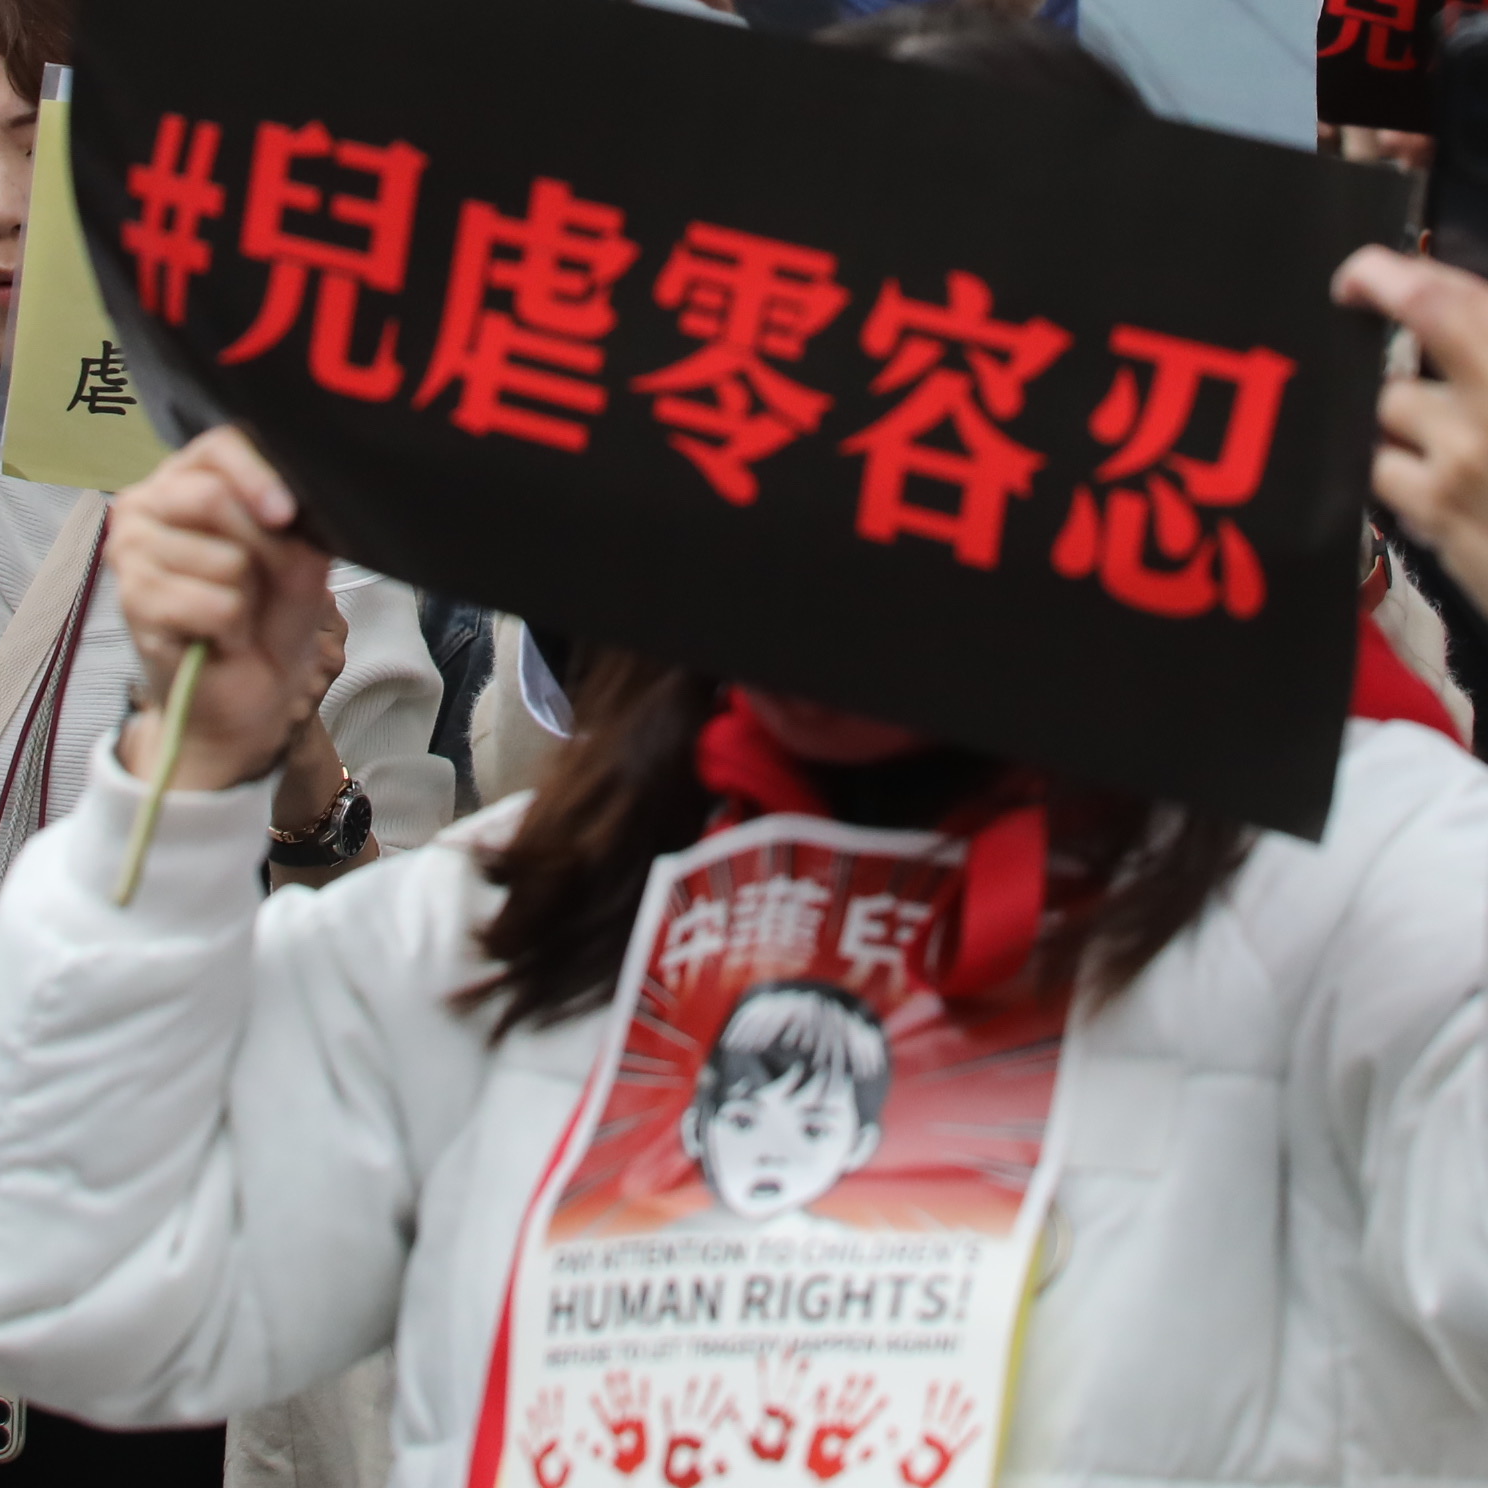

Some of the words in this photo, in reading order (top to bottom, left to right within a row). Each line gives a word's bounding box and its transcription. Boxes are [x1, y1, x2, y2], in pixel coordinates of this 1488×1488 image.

[67, 340, 138, 415] 虐
[119, 113, 1297, 619] #兒虐零容忍
[547, 1275, 727, 1336] HUMAN
[739, 1271, 975, 1324] RIGHTS!
